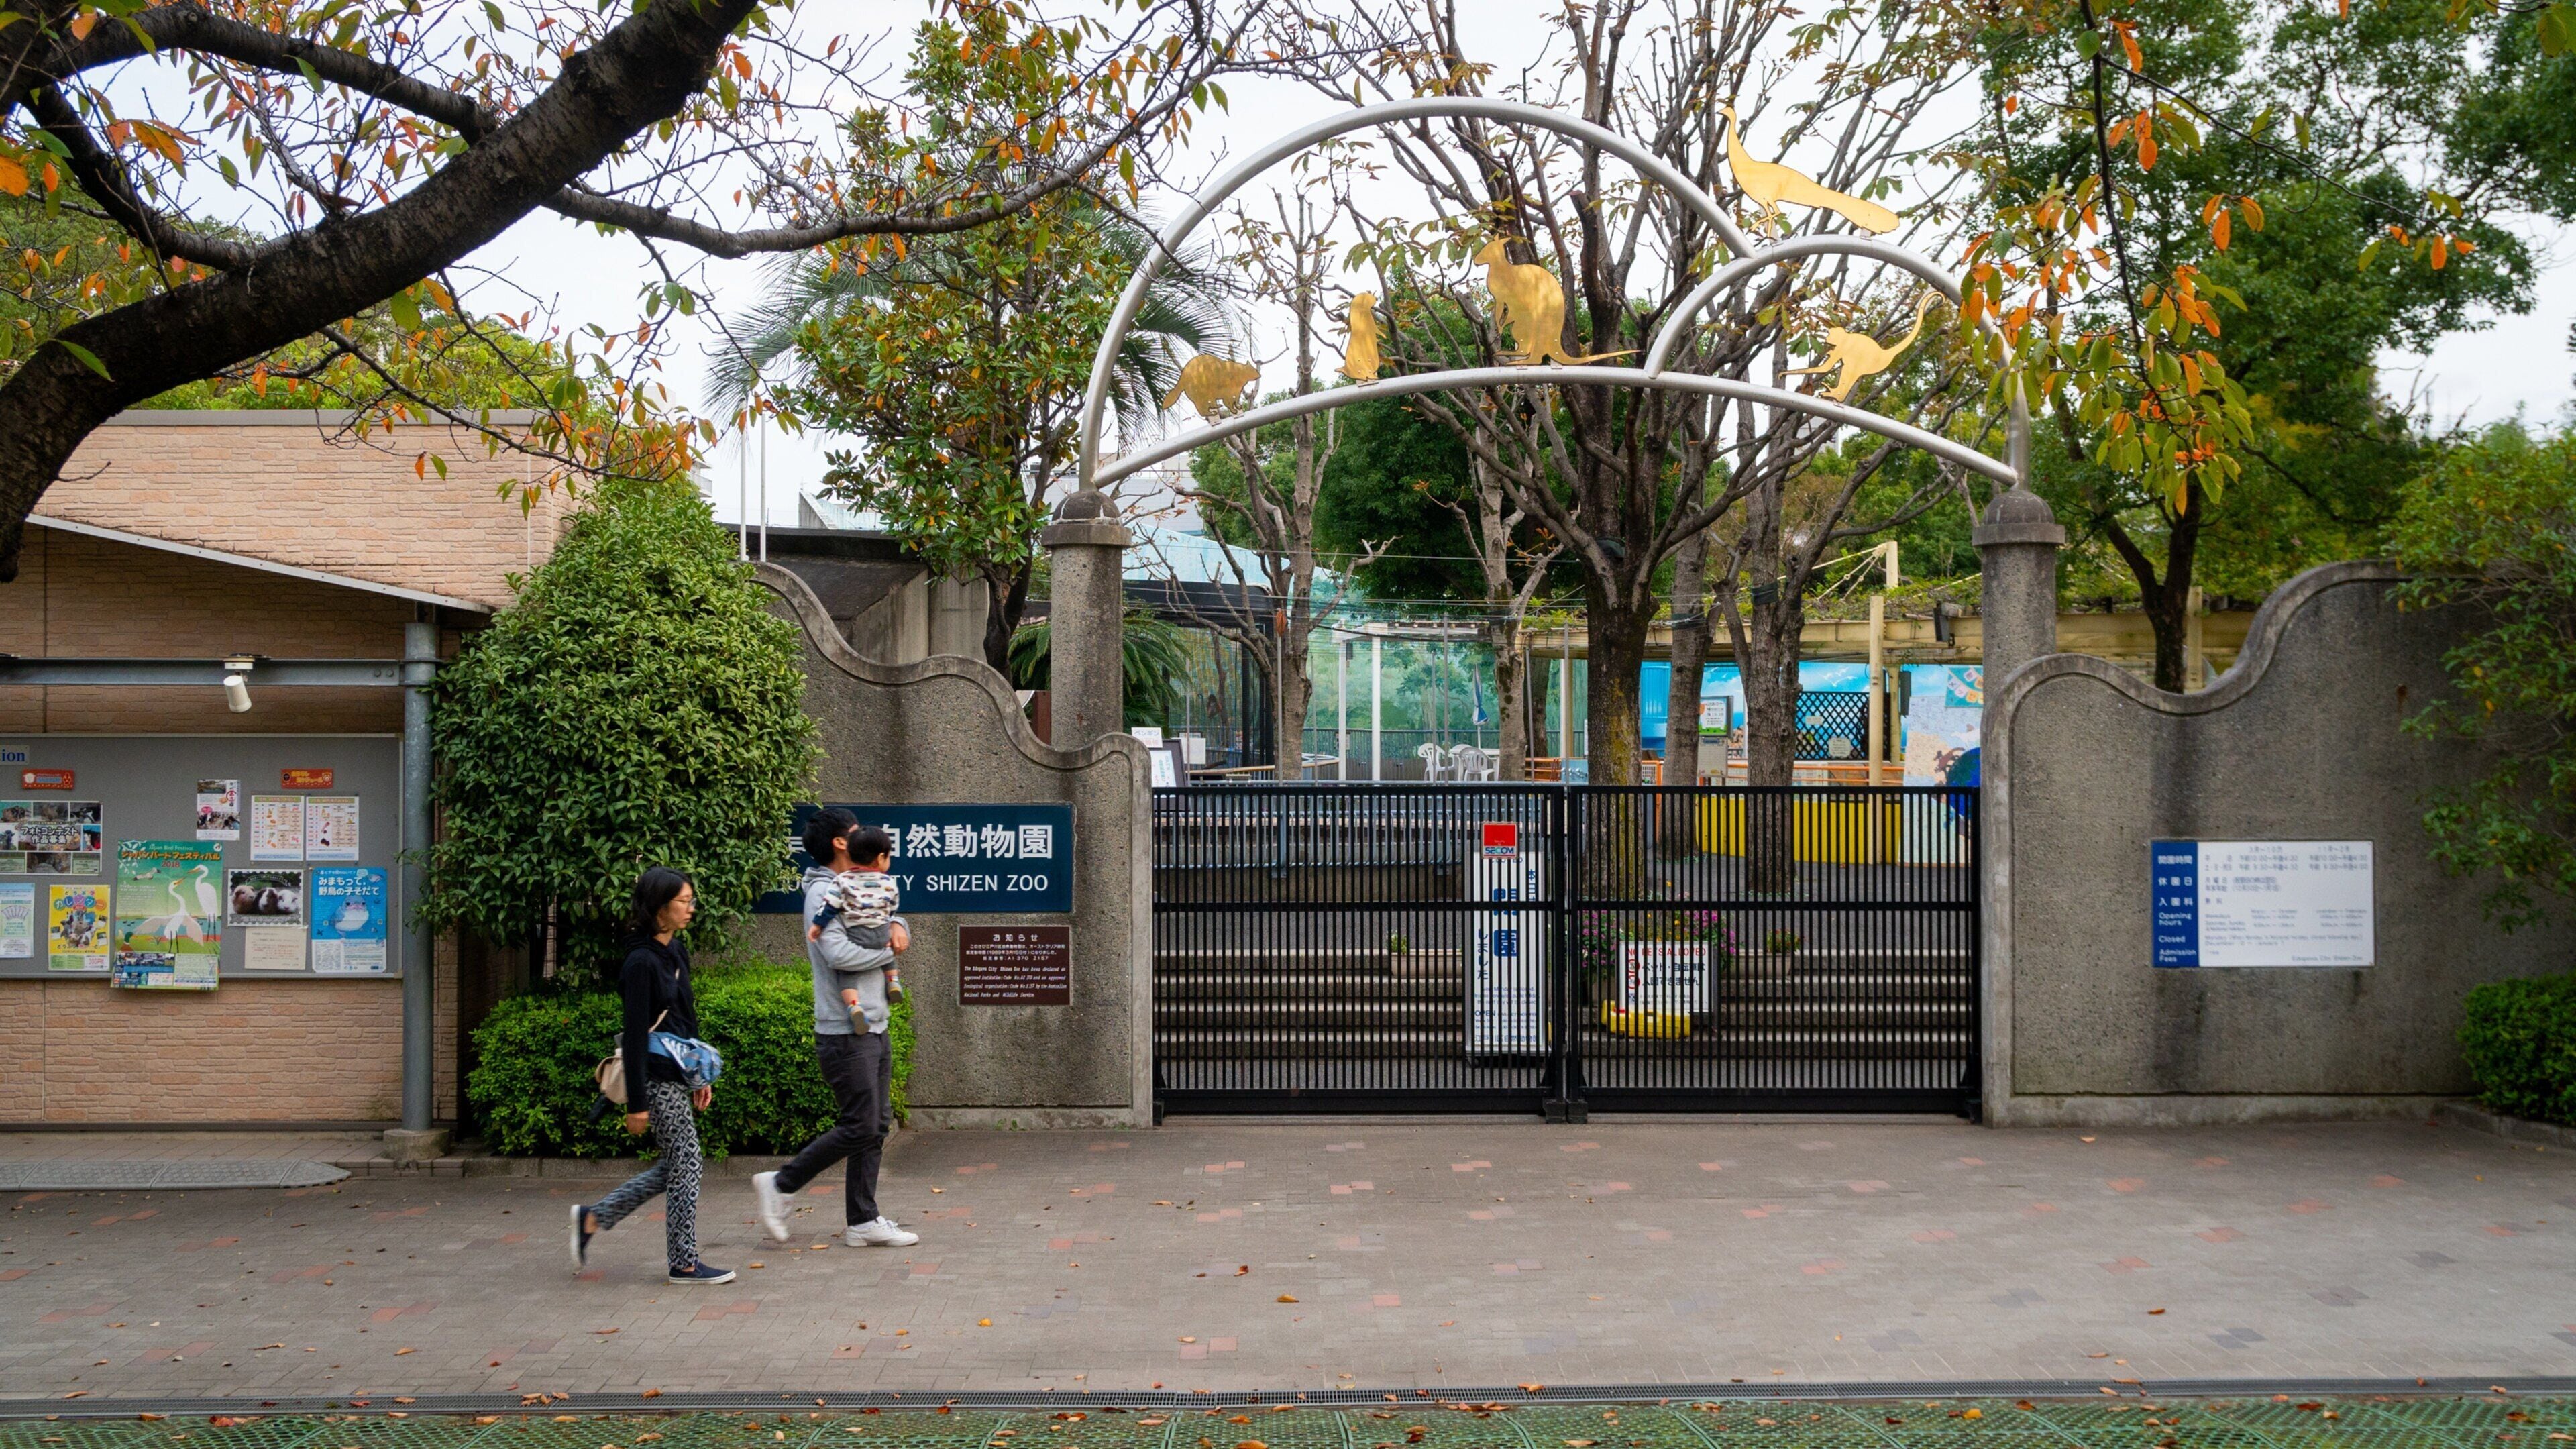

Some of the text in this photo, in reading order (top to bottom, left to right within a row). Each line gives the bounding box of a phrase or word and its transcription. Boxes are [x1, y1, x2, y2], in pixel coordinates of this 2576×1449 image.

[21, 826, 78, 836] フォトコンテスト
[890, 874, 1049, 892] TY SHIZEN ZOO
[2158, 877, 2192, 886] 休園日
[319, 886, 380, 896] 野鳥の子そだて
[993, 934, 1038, 942] お知らせ
